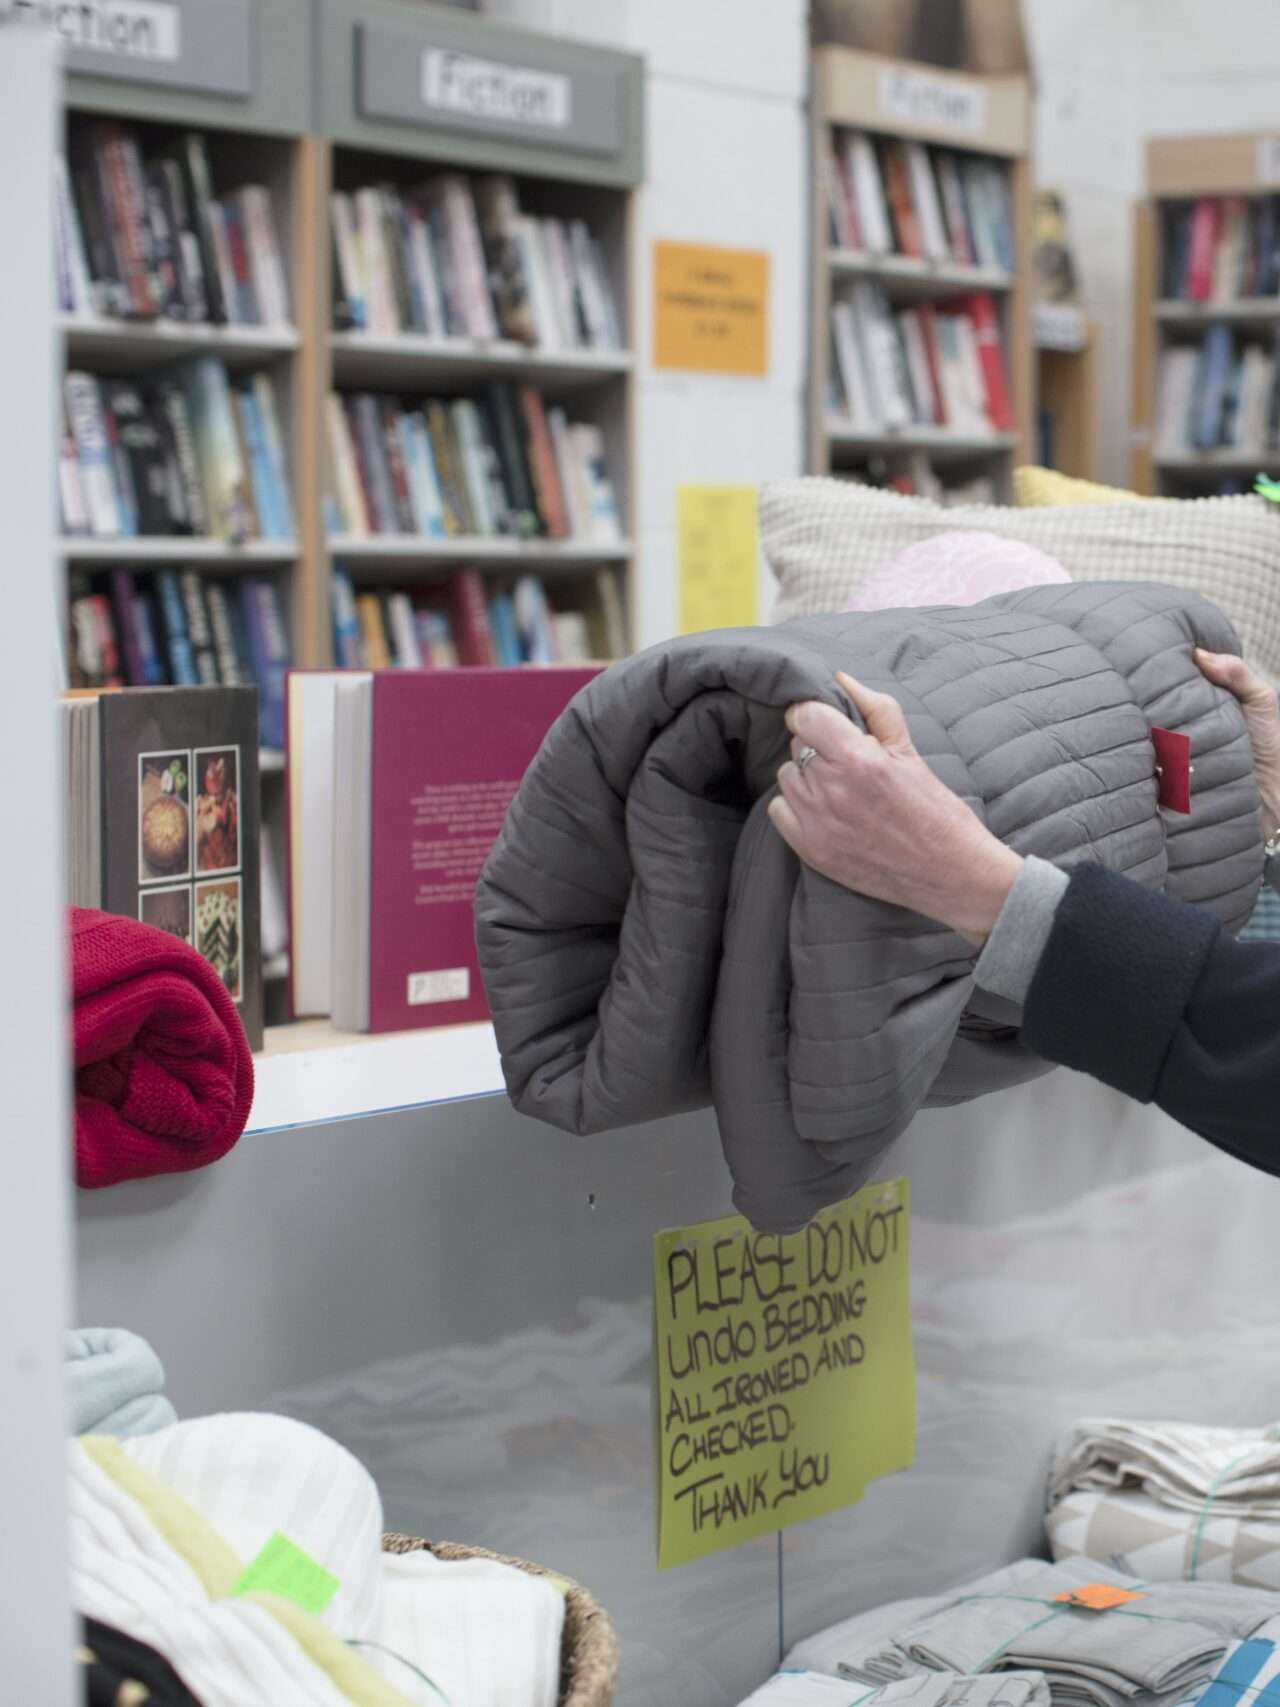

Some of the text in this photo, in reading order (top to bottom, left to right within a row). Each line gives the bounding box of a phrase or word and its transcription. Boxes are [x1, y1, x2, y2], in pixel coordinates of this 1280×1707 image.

[667, 1204, 903, 1320] PLEASE DO NOT
[762, 1279, 868, 1353] BEDDING
[665, 1332, 866, 1433] ALL IRONED AND
[673, 1471, 769, 1533] THANK
